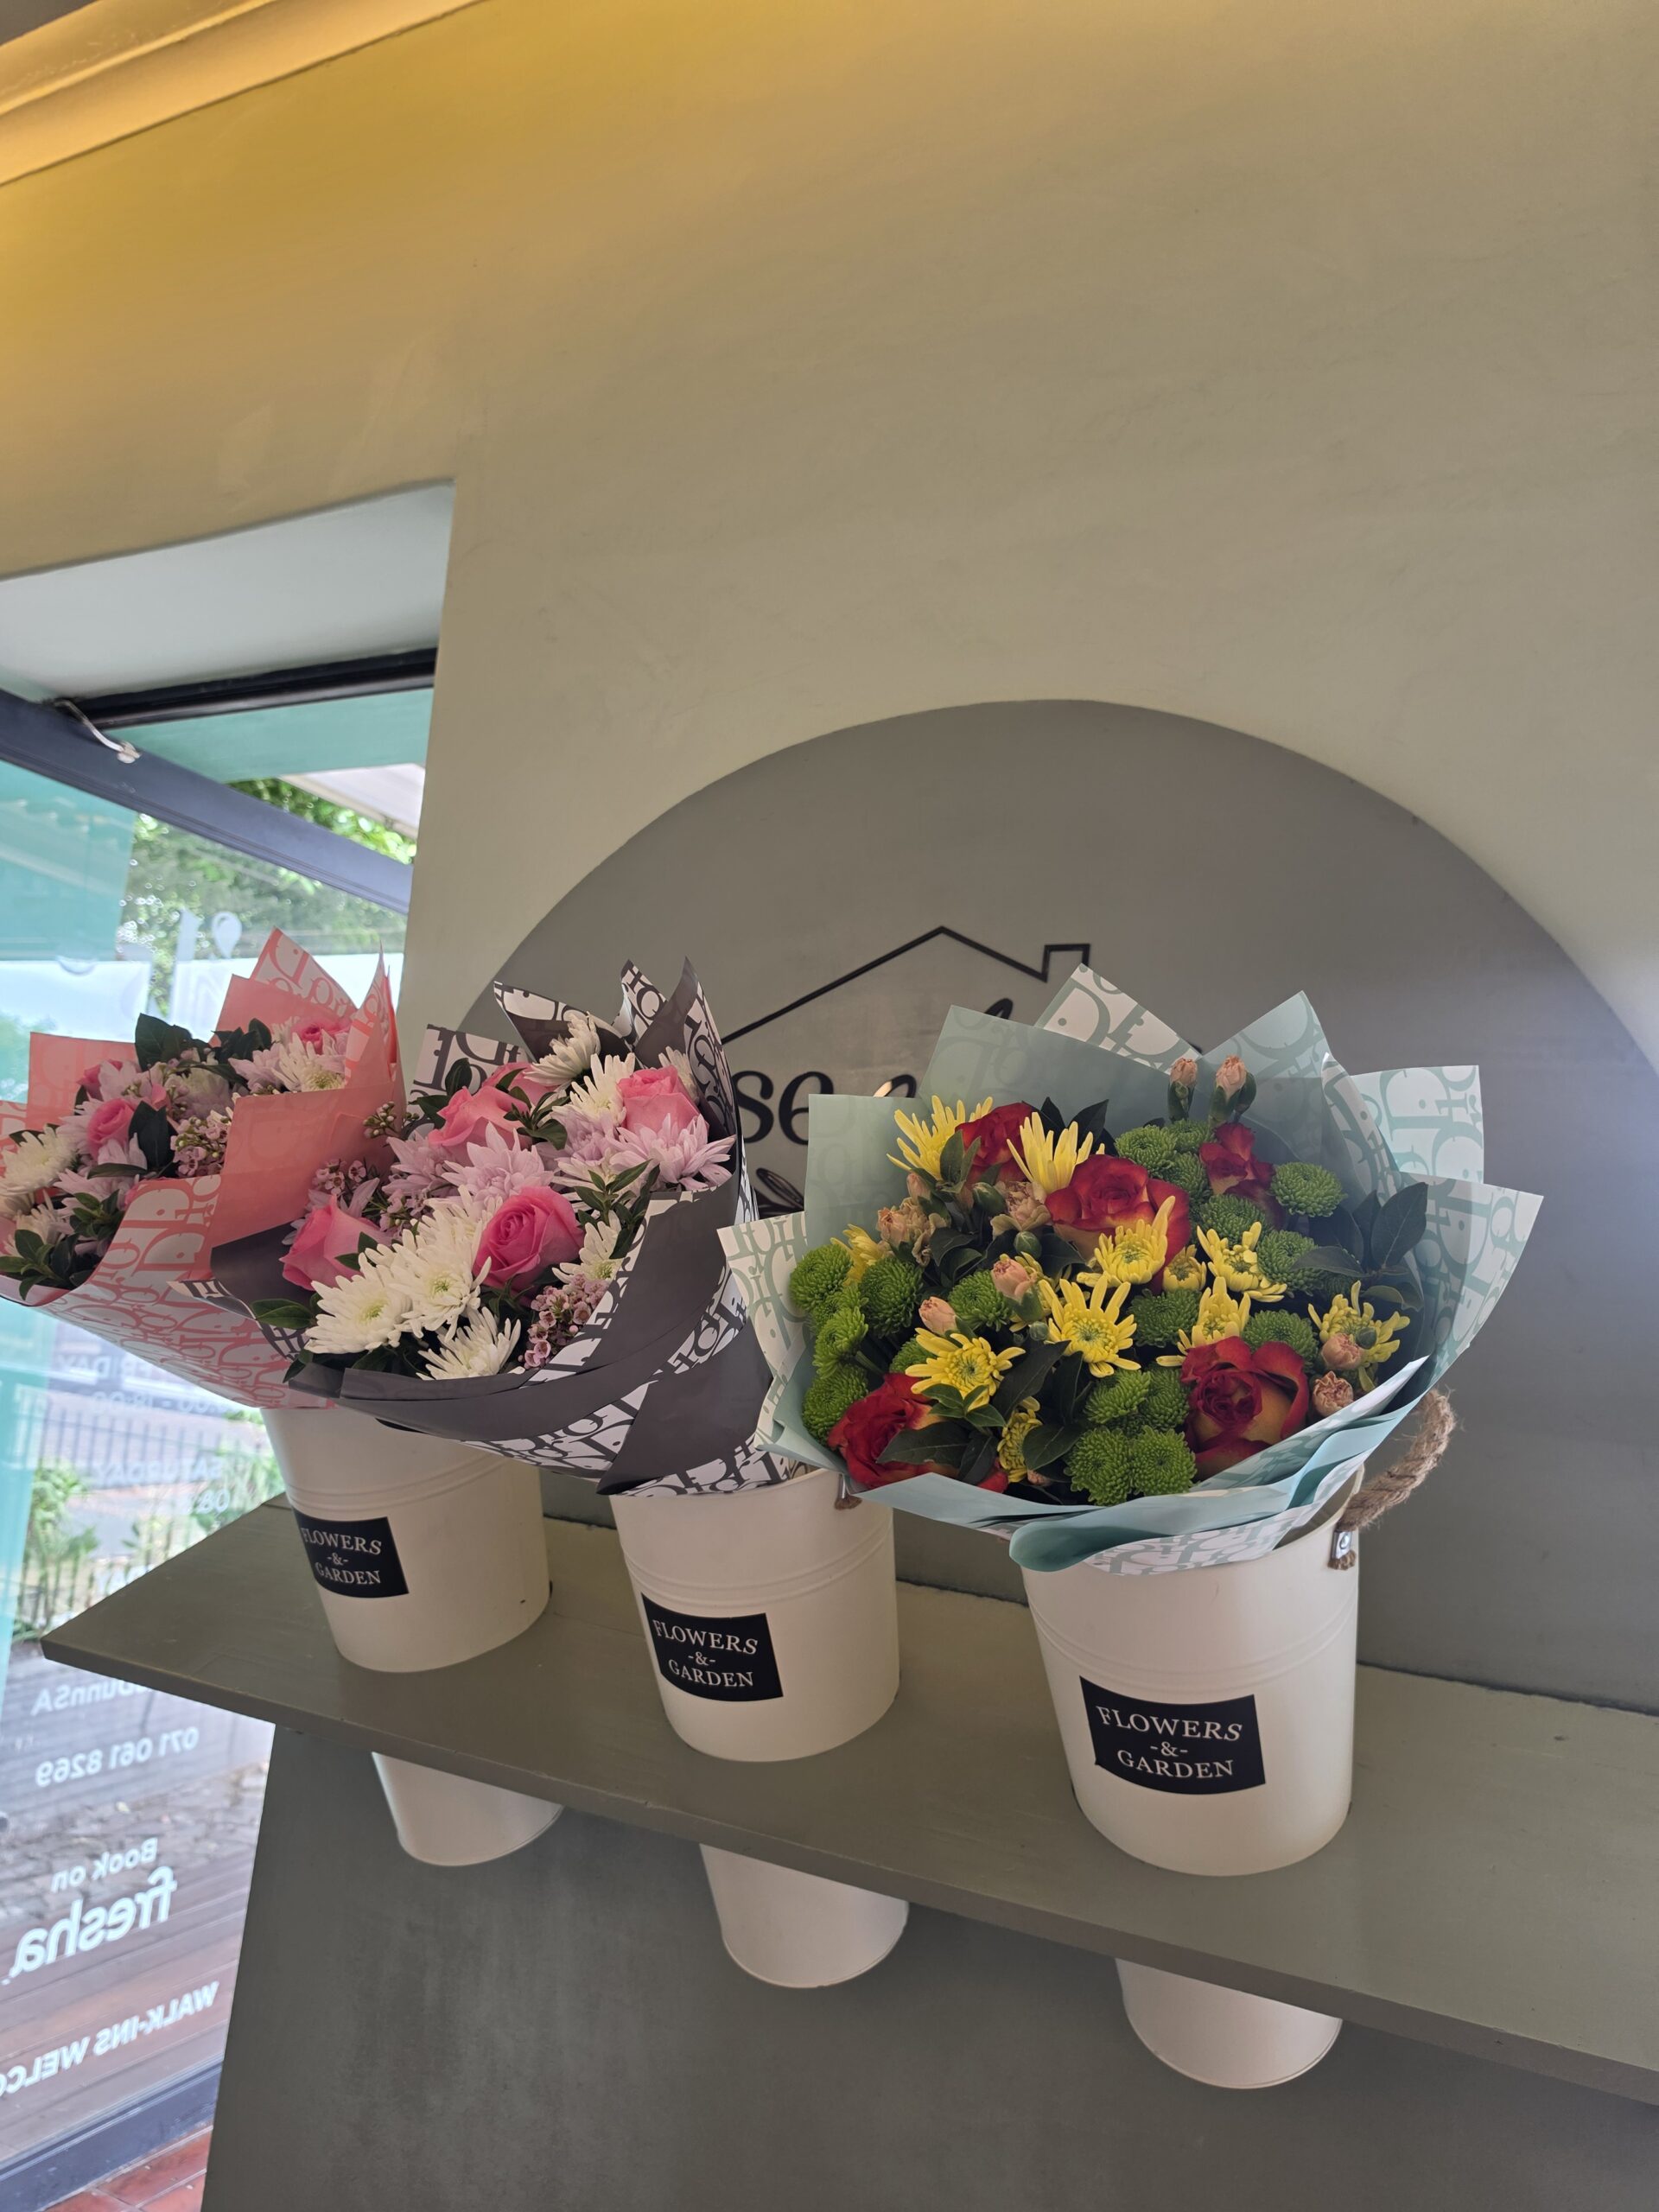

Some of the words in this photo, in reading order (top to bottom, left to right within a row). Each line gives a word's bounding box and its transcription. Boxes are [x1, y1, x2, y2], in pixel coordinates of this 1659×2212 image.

[301, 1527, 382, 1555] FLOWERS
[315, 1561, 381, 1585] GARDEN
[652, 1619, 758, 1655] FLOWERS
[668, 1659, 753, 1687] GARDEN
[1096, 1706, 1243, 1741] FLOWERS
[1117, 1750, 1234, 1779] GARDEN
